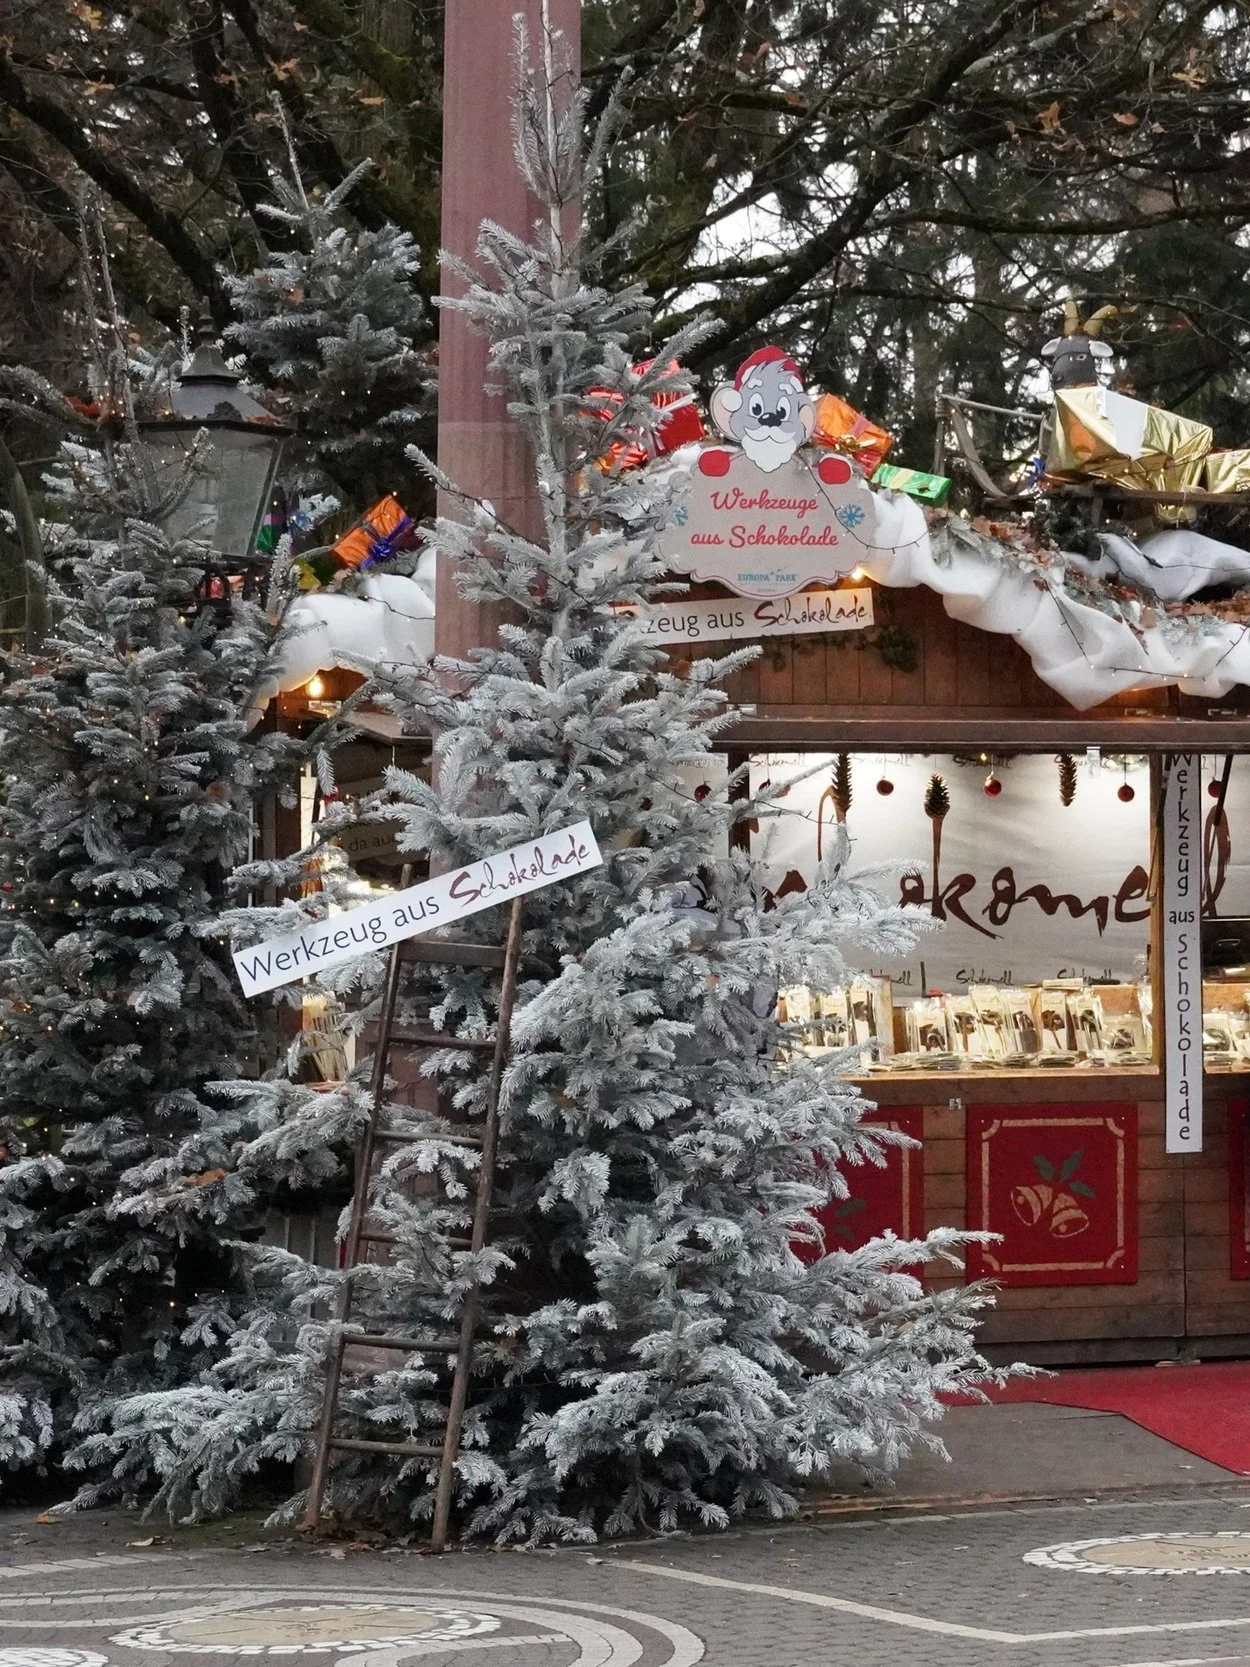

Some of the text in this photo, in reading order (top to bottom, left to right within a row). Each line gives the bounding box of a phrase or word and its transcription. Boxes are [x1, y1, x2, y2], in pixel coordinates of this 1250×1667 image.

[710, 488, 818, 519] Werkzeuge
[691, 524, 839, 549] aus Schokolade
[738, 573, 798, 582] EUROPA PARK
[707, 610, 745, 629] aus
[754, 595, 868, 628] Schokolade
[1172, 755, 1193, 897] Werkzeug
[240, 834, 591, 982] Werkzeug aus Schokolade
[1168, 911, 1195, 923] aus
[1177, 934, 1192, 1140] Schokolade
